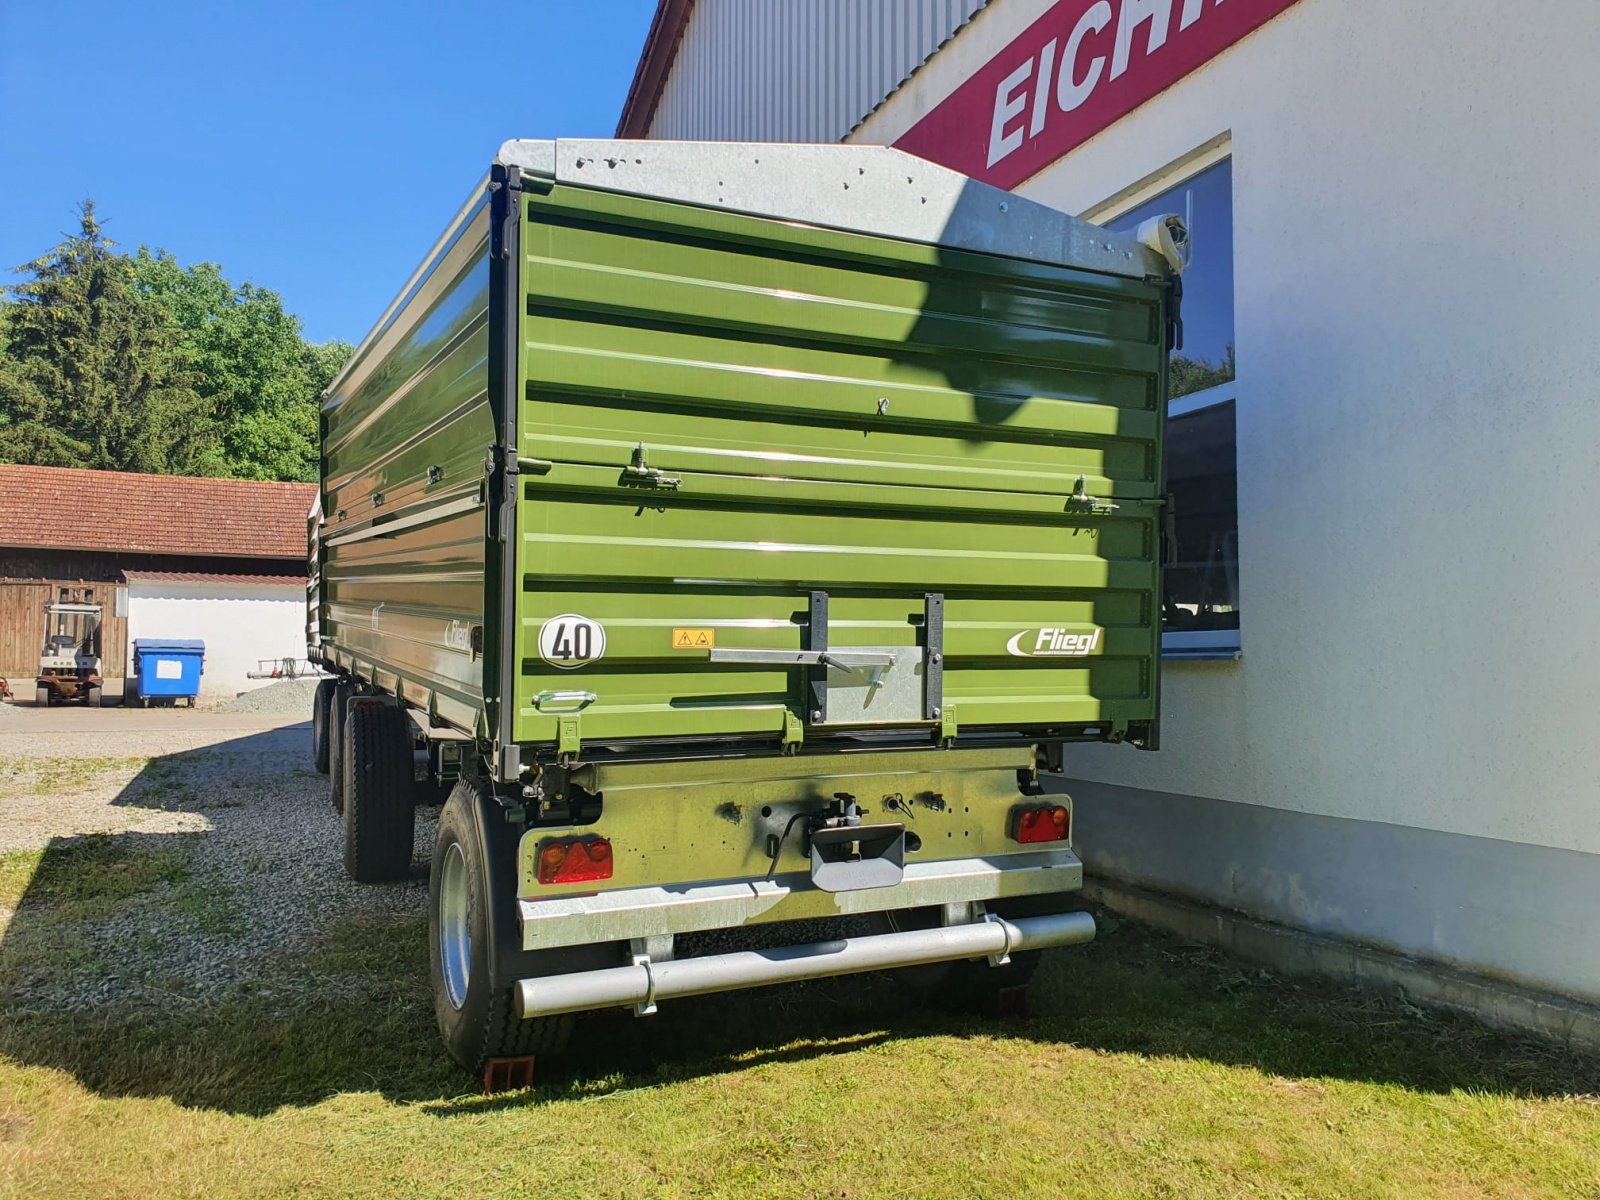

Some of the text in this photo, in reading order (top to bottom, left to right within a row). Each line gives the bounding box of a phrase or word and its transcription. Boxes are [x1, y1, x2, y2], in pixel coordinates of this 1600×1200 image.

[986, 0, 1225, 170] EICH
[551, 623, 592, 661] 40
[1034, 628, 1101, 655] Fliegl
